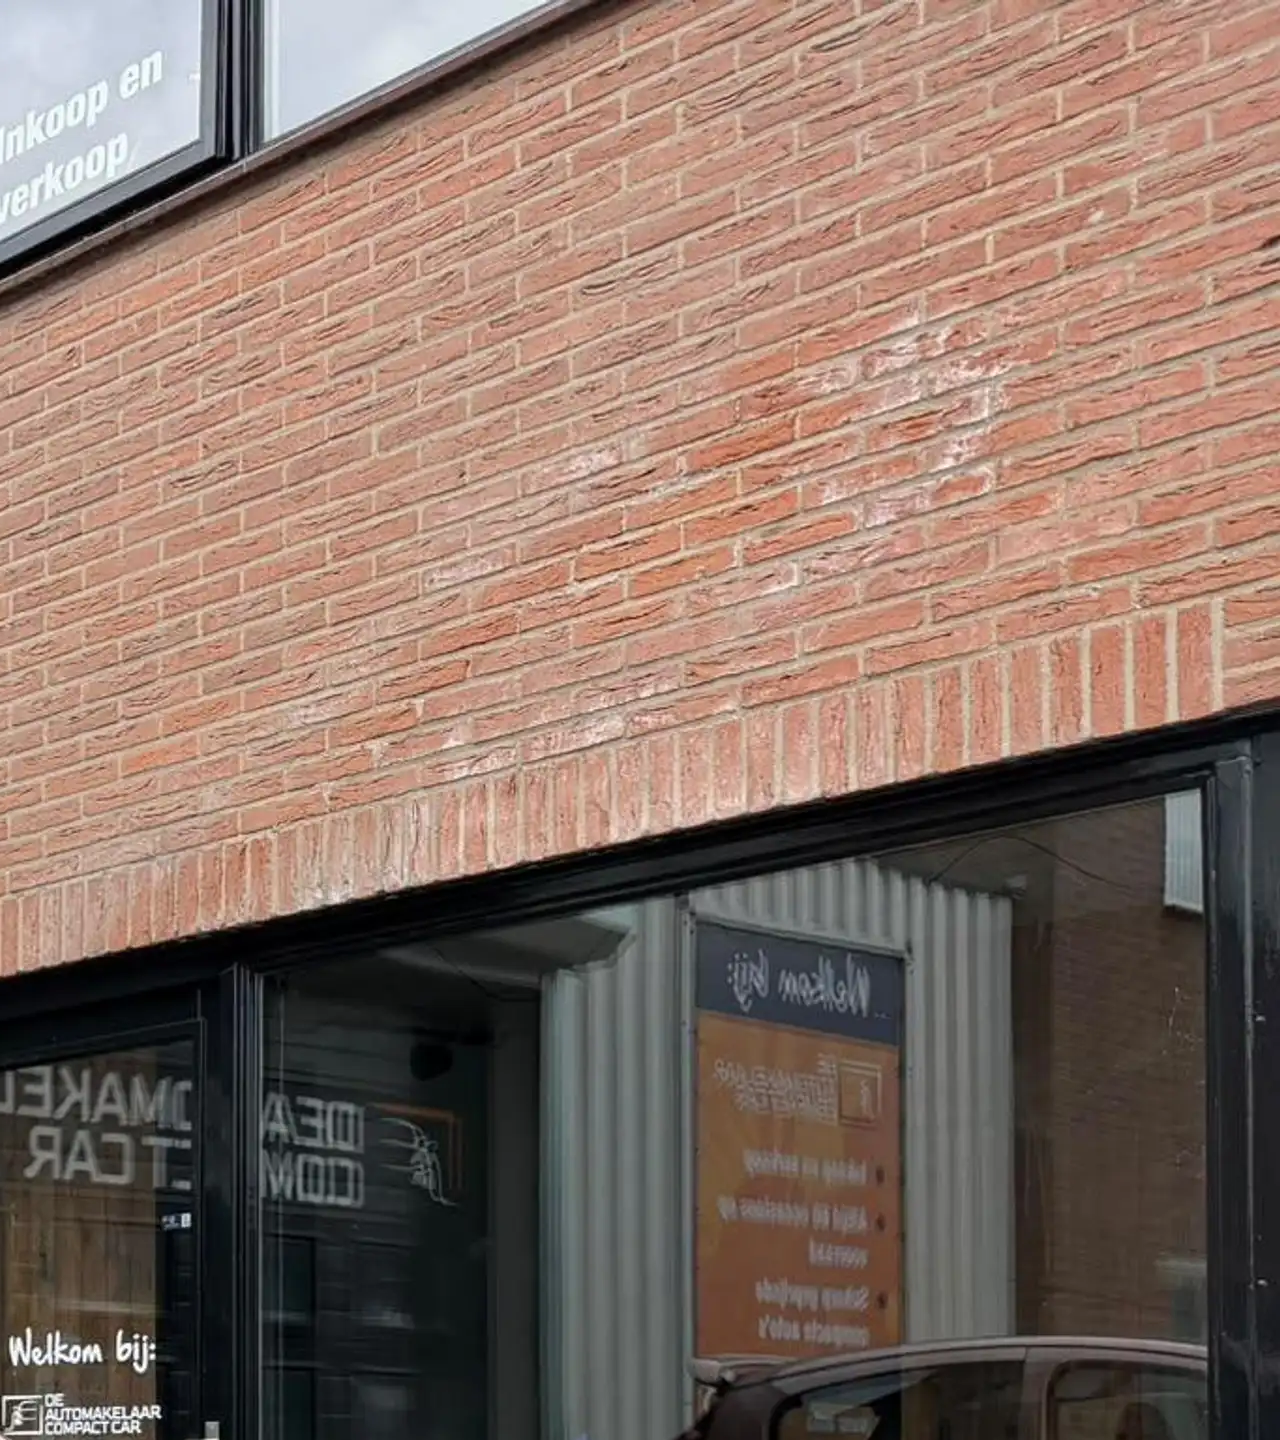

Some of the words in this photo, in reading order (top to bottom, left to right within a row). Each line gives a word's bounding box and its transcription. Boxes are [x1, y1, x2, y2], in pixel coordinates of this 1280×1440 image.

[119, 49, 163, 99] en
[9, 1327, 103, 1367] Welkom
[116, 1328, 157, 1374] bij:
[45, 1393, 65, 1407] DE
[44, 1404, 163, 1421] AUTOMAKELAAR
[44, 1420, 109, 1436] COMPACT
[111, 1420, 143, 1435] CAR
